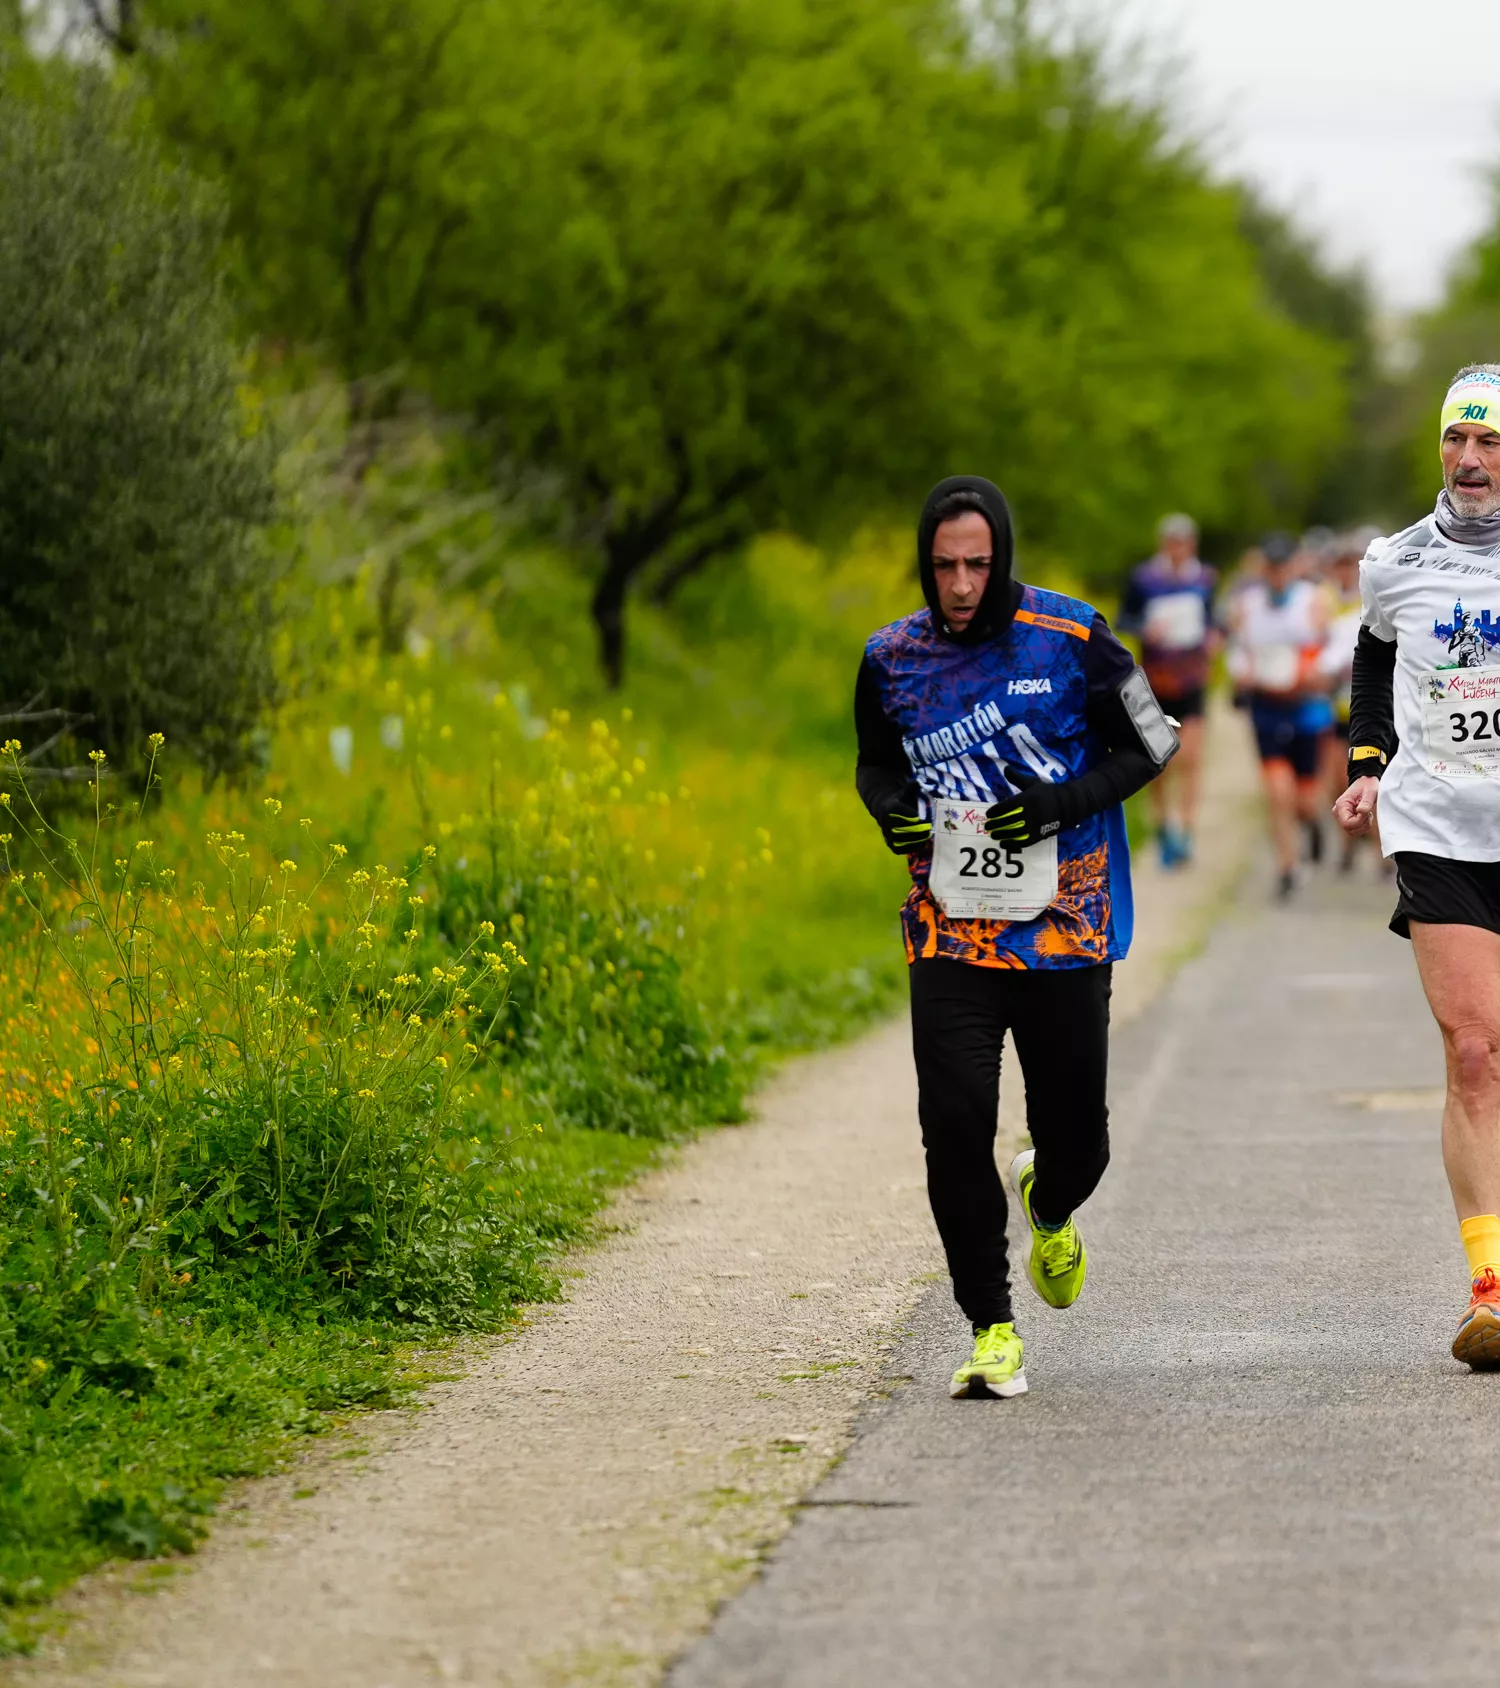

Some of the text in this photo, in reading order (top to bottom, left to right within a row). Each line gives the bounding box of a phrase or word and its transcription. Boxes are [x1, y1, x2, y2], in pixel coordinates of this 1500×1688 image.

[1457, 403, 1488, 420] 10K
[1007, 678, 1052, 695] HOKA
[916, 700, 1006, 765] MARATÓN
[959, 846, 1024, 878] 285
